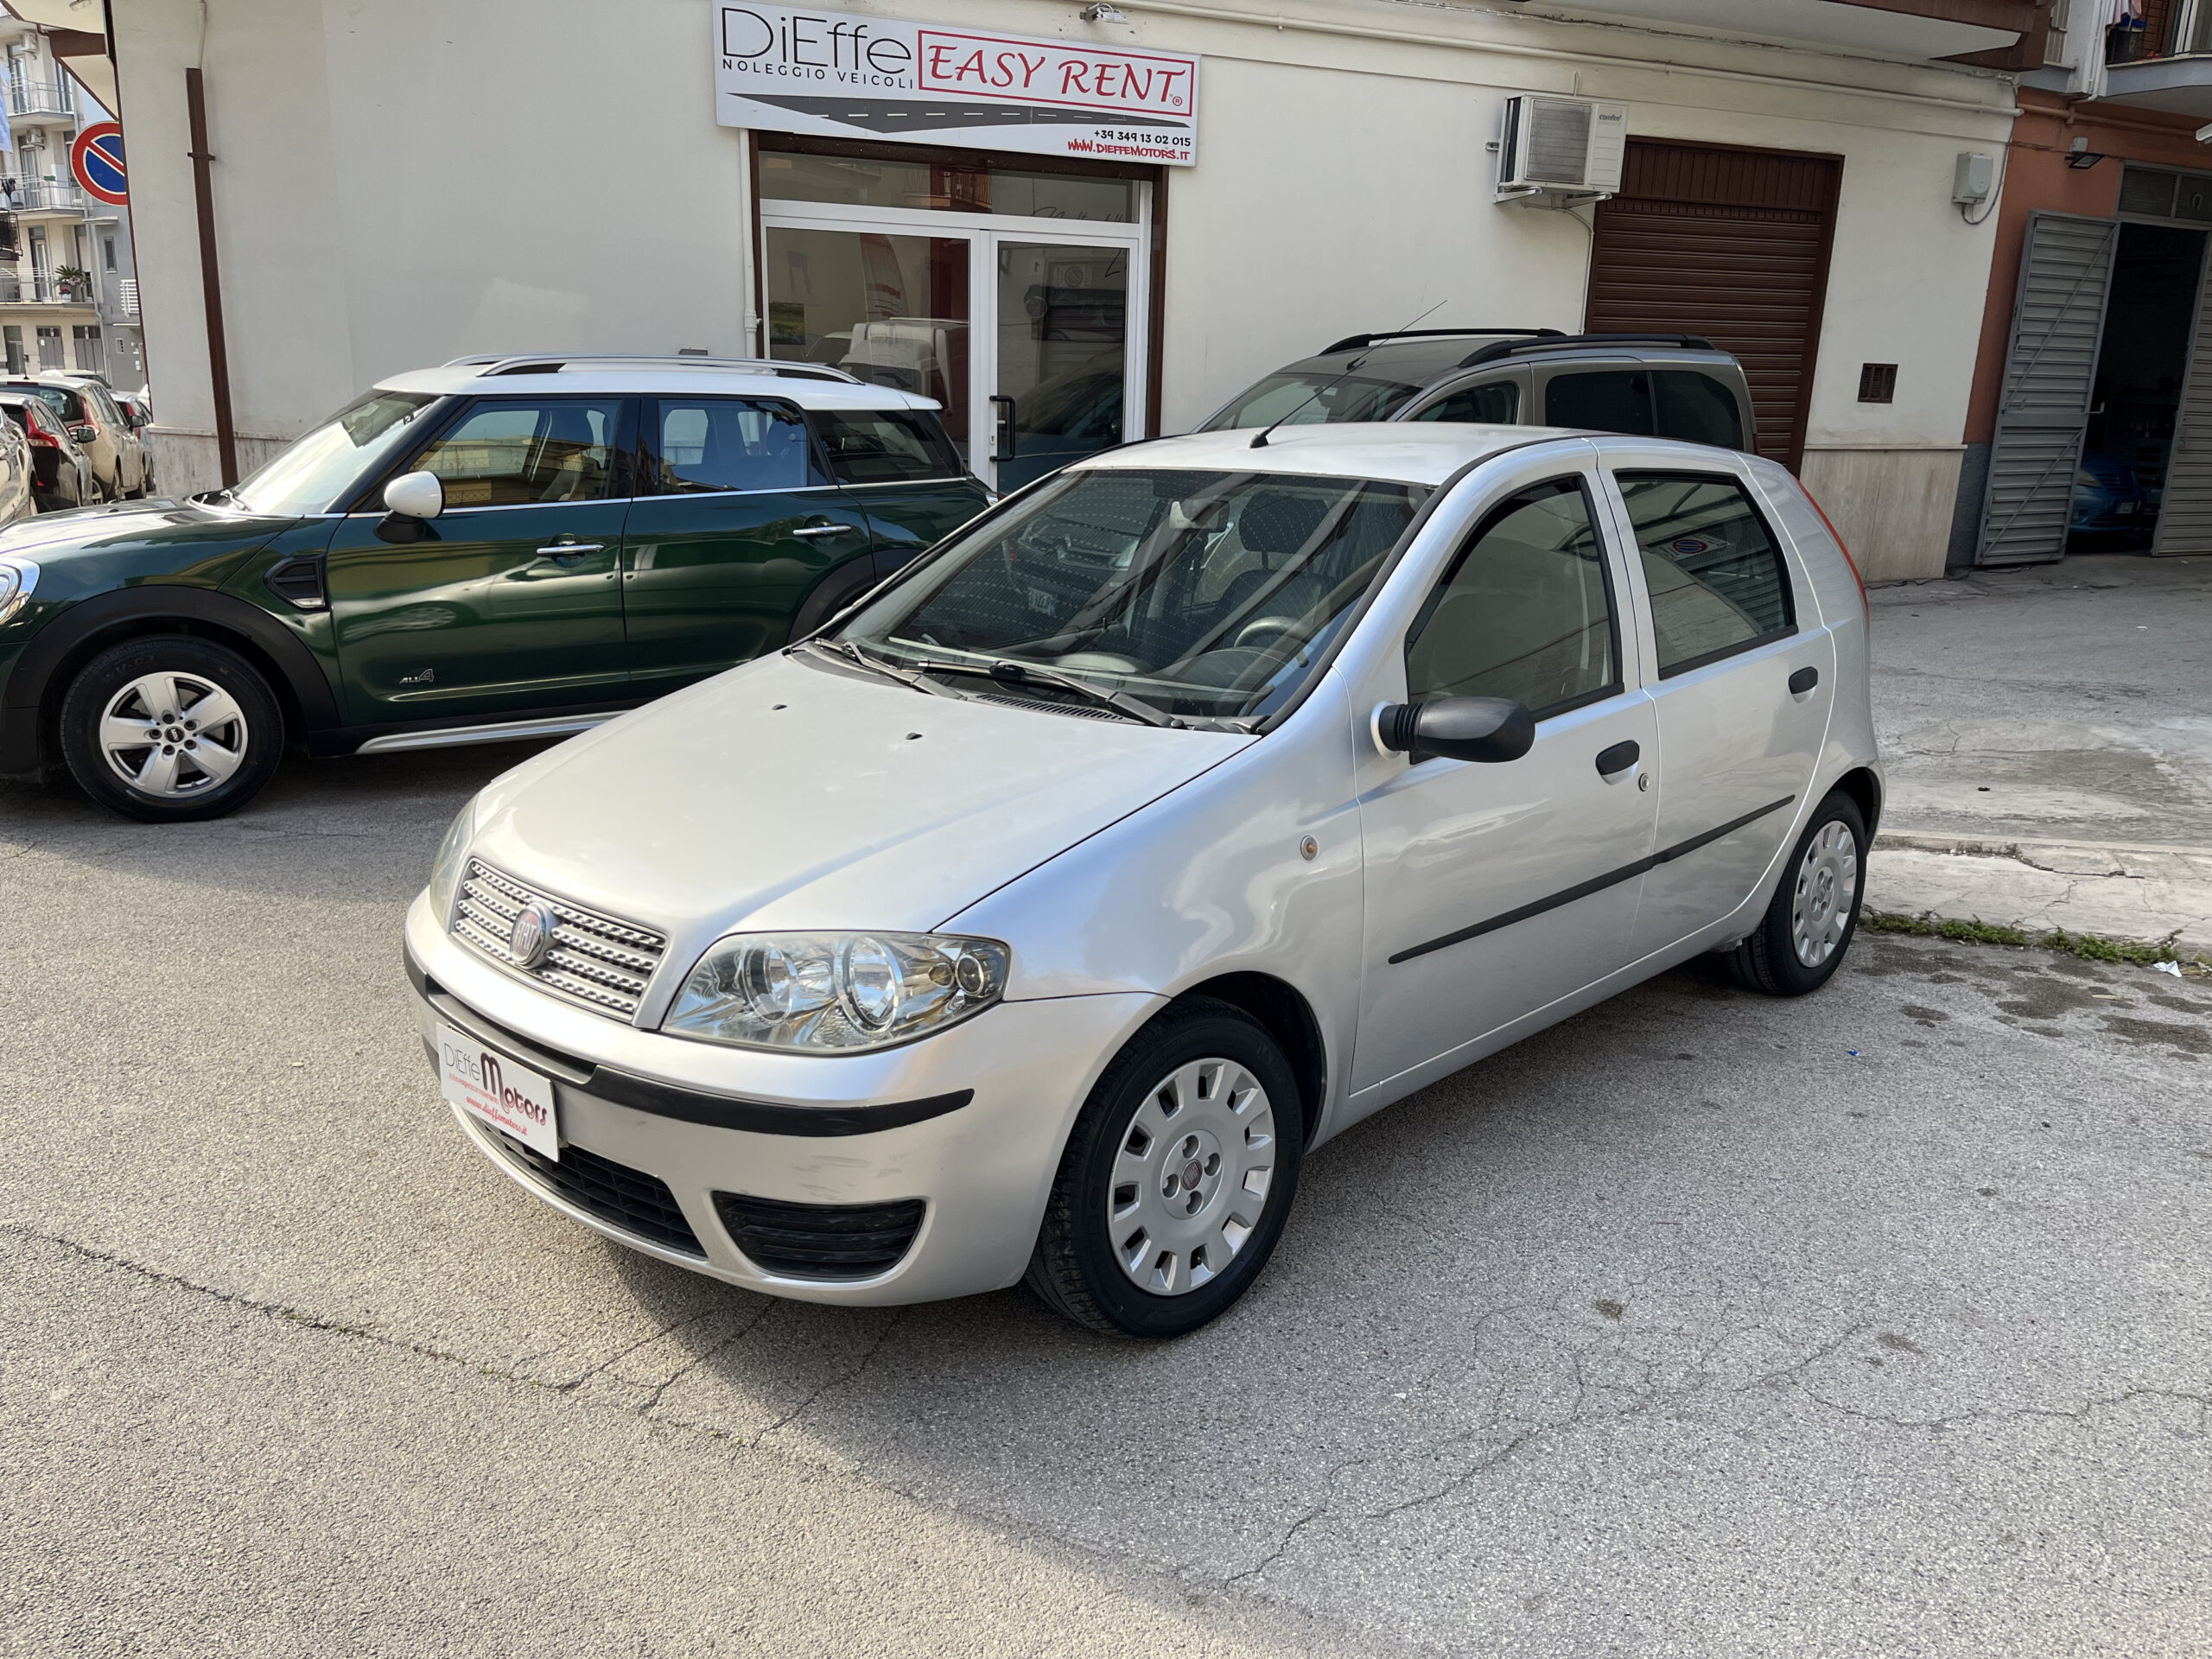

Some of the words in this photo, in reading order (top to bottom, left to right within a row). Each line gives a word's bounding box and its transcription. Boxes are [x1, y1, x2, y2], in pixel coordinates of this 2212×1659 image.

[722, 7, 912, 74] DiEffe
[722, 58, 826, 80] NOLEGGIO
[836, 71, 913, 90] VEICOLI
[928, 44, 1046, 89] EASY
[1058, 60, 1186, 103] RENT
[1094, 130, 1115, 140] +39
[1117, 131, 1137, 142] 349
[1140, 133, 1152, 143] 13
[1154, 135, 1169, 145] 02
[1172, 137, 1192, 147] 015
[443, 1042, 480, 1081] DiEffe
